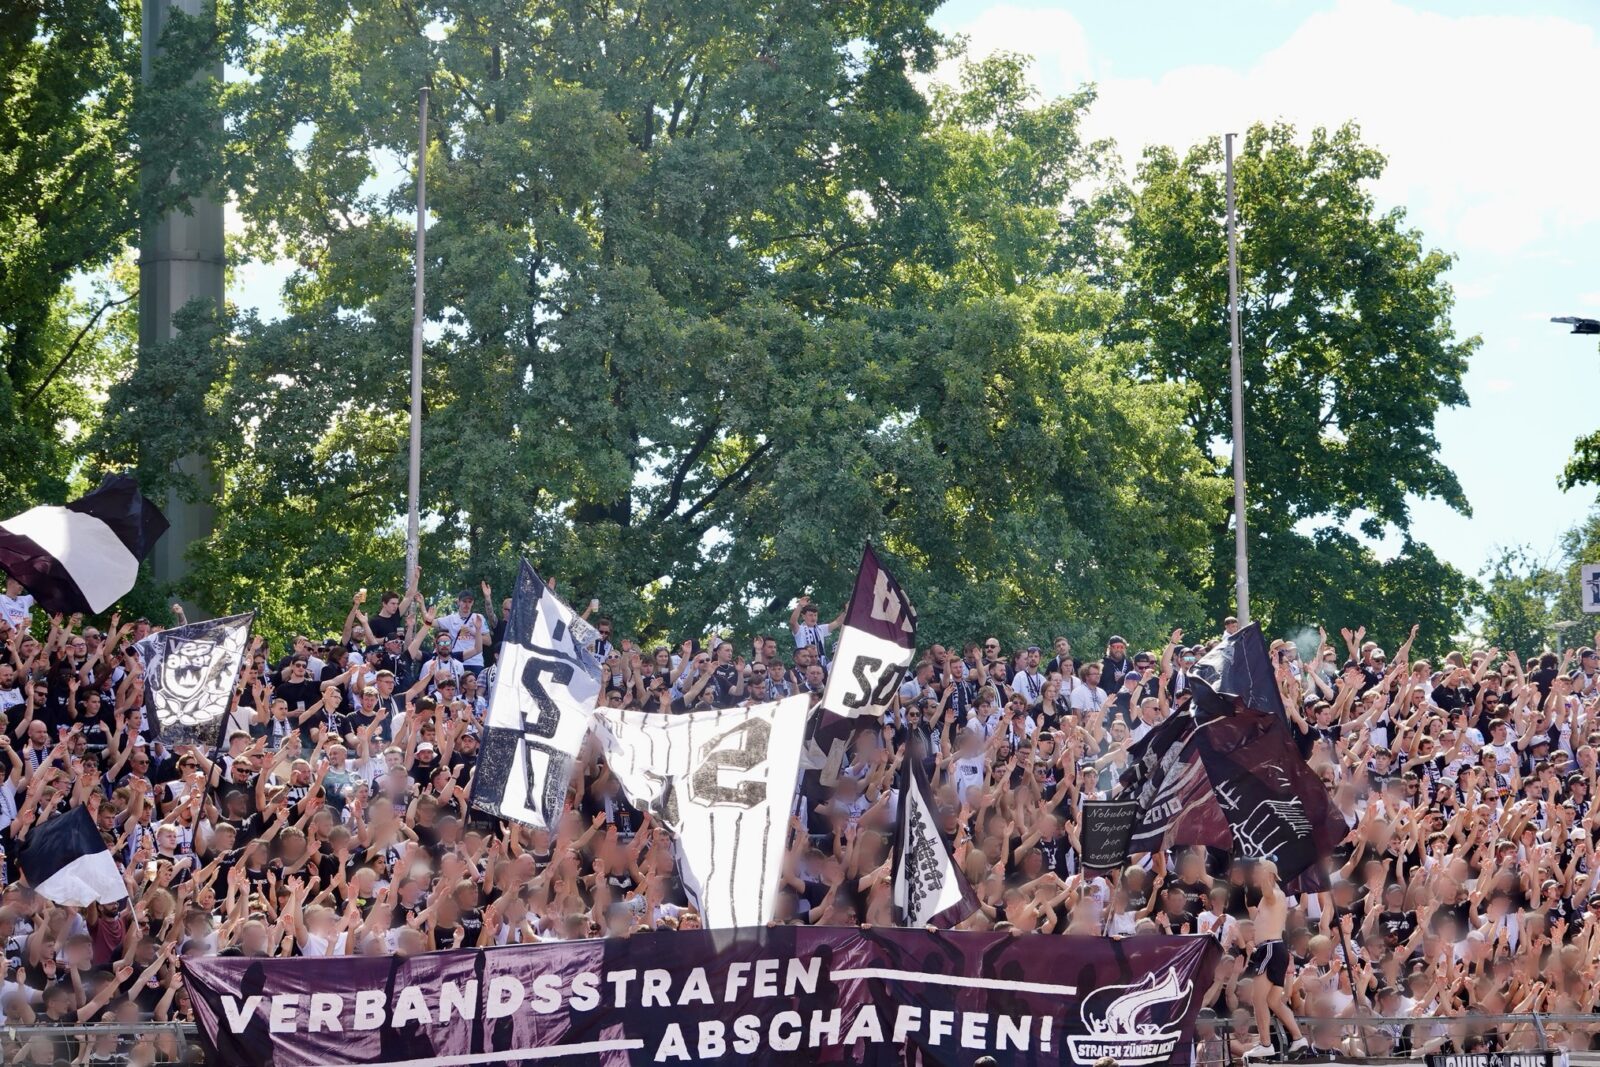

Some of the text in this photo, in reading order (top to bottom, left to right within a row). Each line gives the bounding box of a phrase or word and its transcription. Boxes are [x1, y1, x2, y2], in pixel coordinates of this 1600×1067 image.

[1143, 798, 1184, 825] 2010
[221, 957, 822, 1033] VERBANDSSTRAFEN
[653, 1004, 1053, 1062] ABSCHAFFEN!
[1078, 1044, 1121, 1057] STRAFEN
[1123, 1043, 1160, 1057] ZÜNDEN
